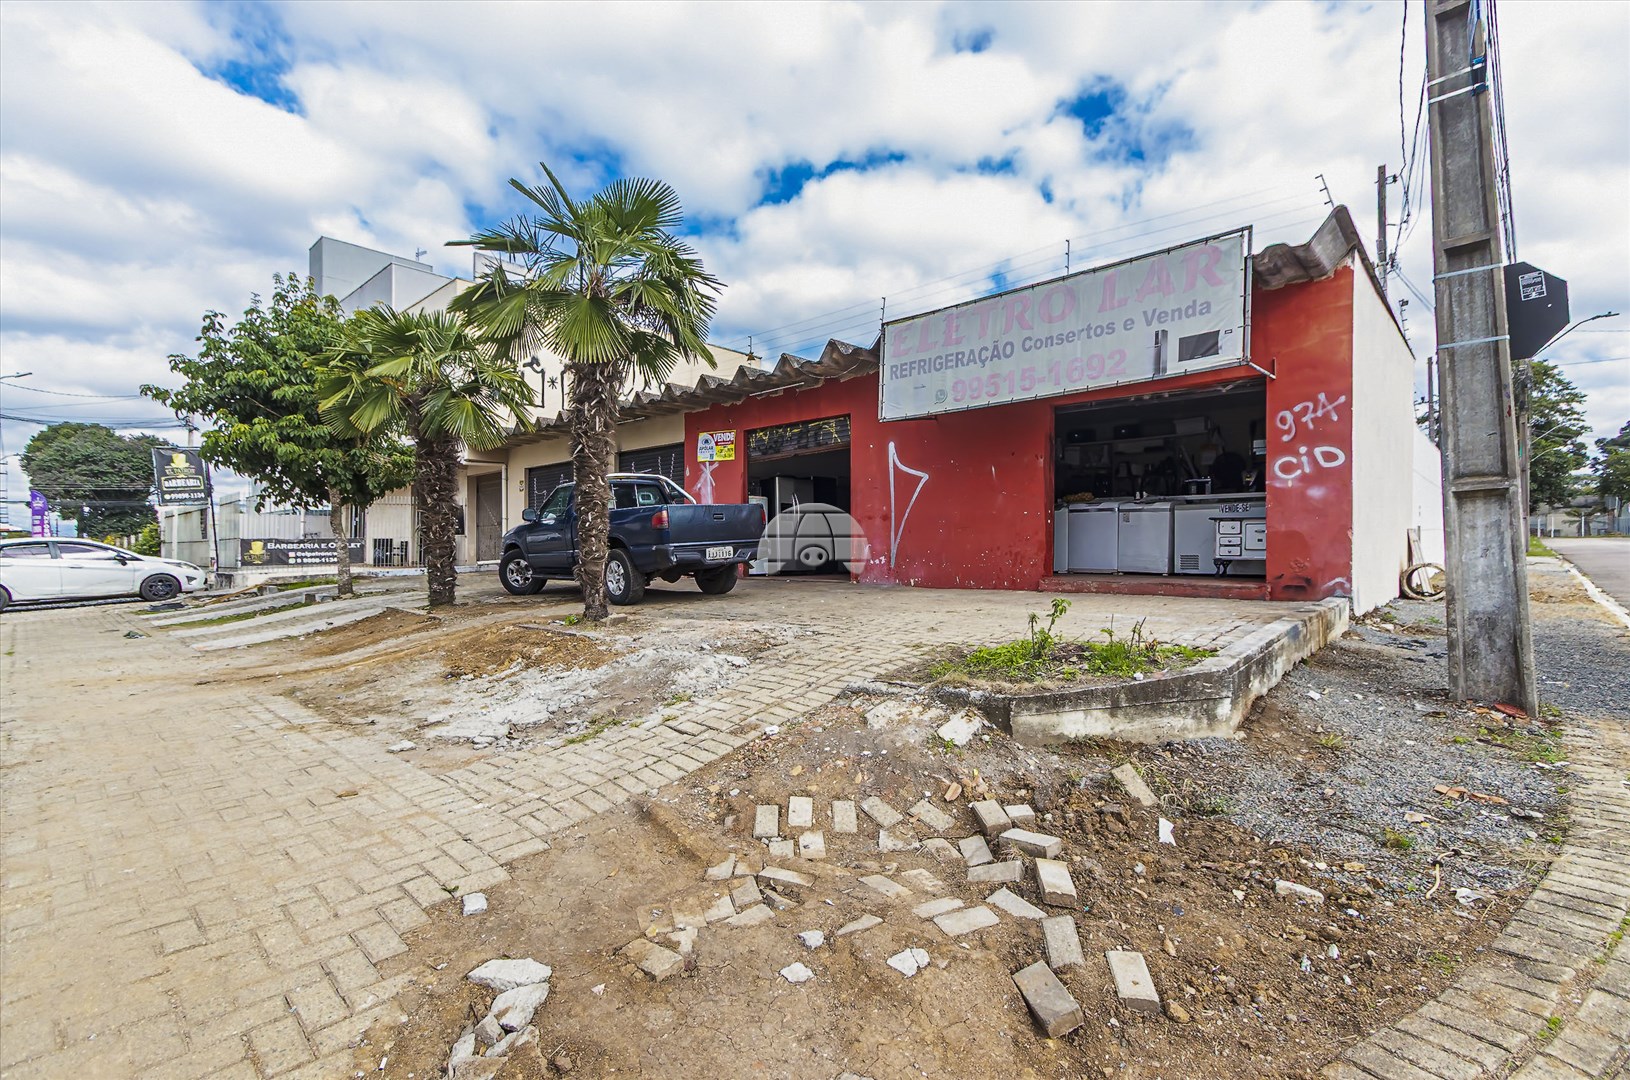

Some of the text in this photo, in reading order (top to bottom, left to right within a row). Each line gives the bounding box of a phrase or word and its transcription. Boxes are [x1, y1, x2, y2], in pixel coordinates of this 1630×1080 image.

[890, 246, 1226, 358] ELETRO LAR
[890, 299, 1212, 380] REFRIGERAÇÃO Consertos e Venda
[951, 348, 1128, 402] 99515-1692
[713, 432, 735, 442] VENDE
